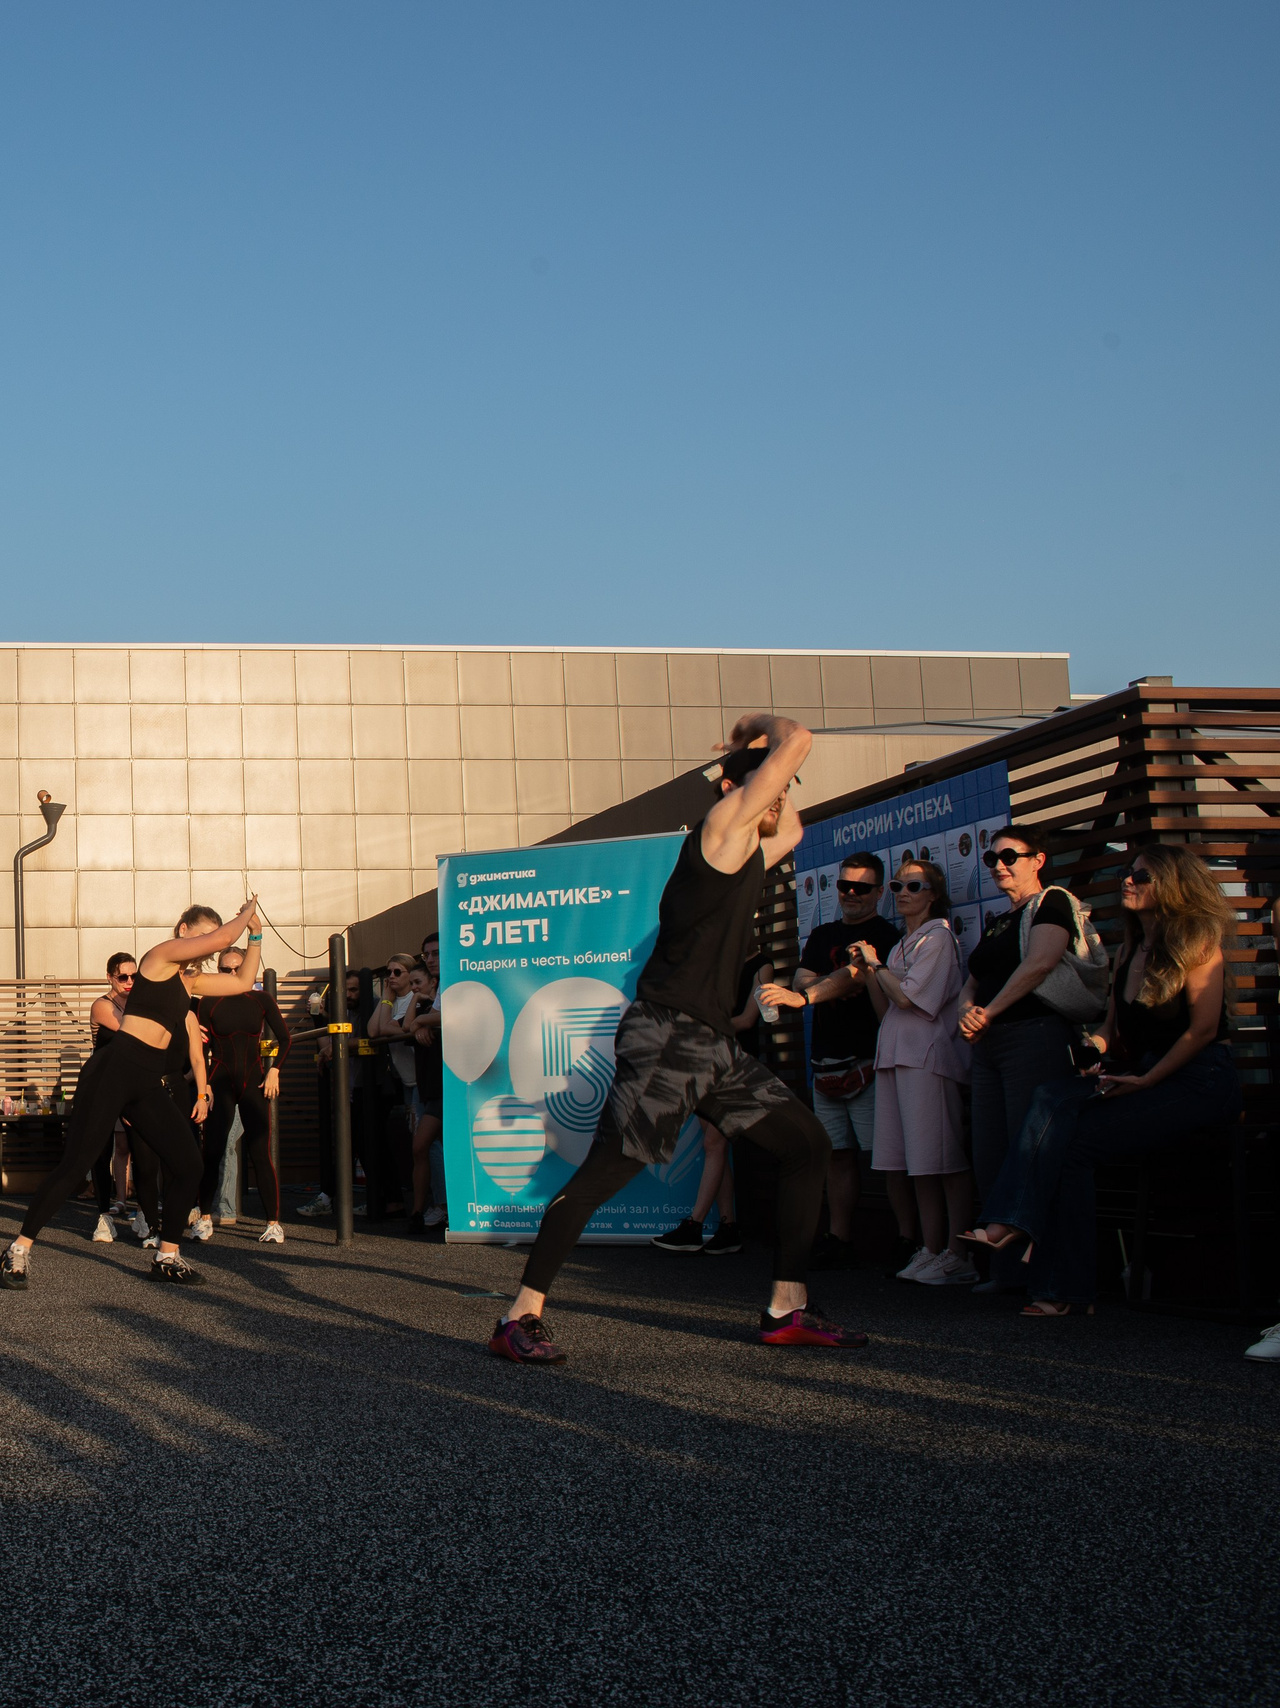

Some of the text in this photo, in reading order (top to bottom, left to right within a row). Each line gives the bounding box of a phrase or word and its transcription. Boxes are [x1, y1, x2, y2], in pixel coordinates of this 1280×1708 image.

[833, 794, 953, 847] ИСТОРИИ УСПЕХА
[470, 869, 536, 885] джиматика
[458, 887, 613, 915] «ДЖИМАТИКЕ»
[459, 918, 549, 947] 5 ЛЕТ!
[459, 948, 632, 973] Подарки в честь юбилея!
[467, 1202, 545, 1215] Премиальный
[629, 1206, 649, 1214] зал
[652, 1206, 660, 1214] и
[479, 1221, 492, 1229] ул.
[493, 1220, 533, 1229] Садовая,
